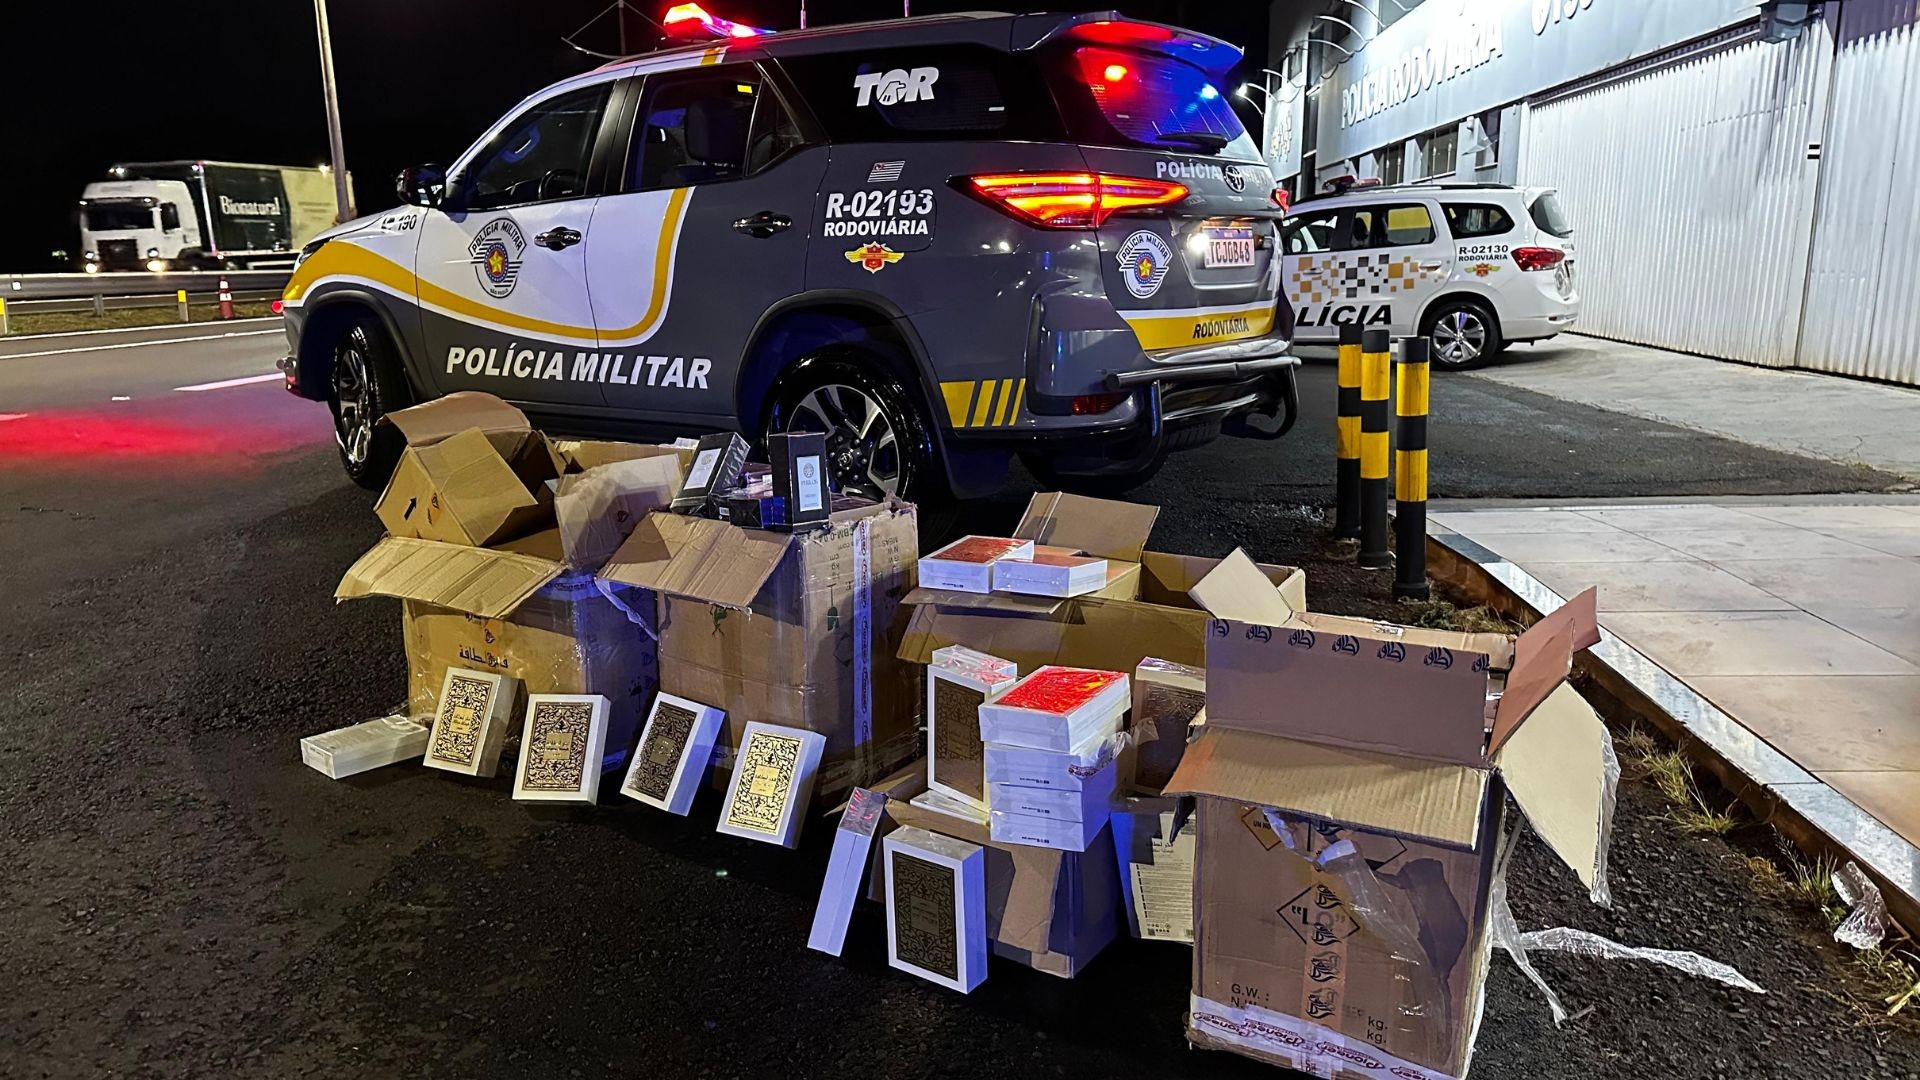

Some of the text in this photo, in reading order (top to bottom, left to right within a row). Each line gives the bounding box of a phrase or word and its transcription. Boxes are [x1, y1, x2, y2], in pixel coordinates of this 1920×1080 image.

[853, 67, 939, 107] TOR
[1156, 159, 1222, 179] POLÍCIA
[219, 195, 280, 215] Bionatural
[825, 188, 934, 219] R-02193
[398, 214, 417, 231] 190
[824, 217, 928, 237] RODOVIÁRIA
[501, 221, 523, 251] MILITAR
[1146, 234, 1169, 259] MILITAR
[1458, 254, 1508, 262] RODOVIÁRIA
[1459, 244, 1508, 255] R-02130
[1296, 302, 1391, 326] LÍCIA
[1193, 316, 1249, 339] RODOVIÁRIA
[446, 343, 711, 389] POLÍCIA MILITAR
[1231, 983, 1260, 999] G.W.
[1243, 1019, 1302, 1046] Pioneer
[1367, 1016, 1388, 1031] kg.
[1366, 1029, 1387, 1044] kg.
[1321, 1042, 1382, 1069] Pioneer
